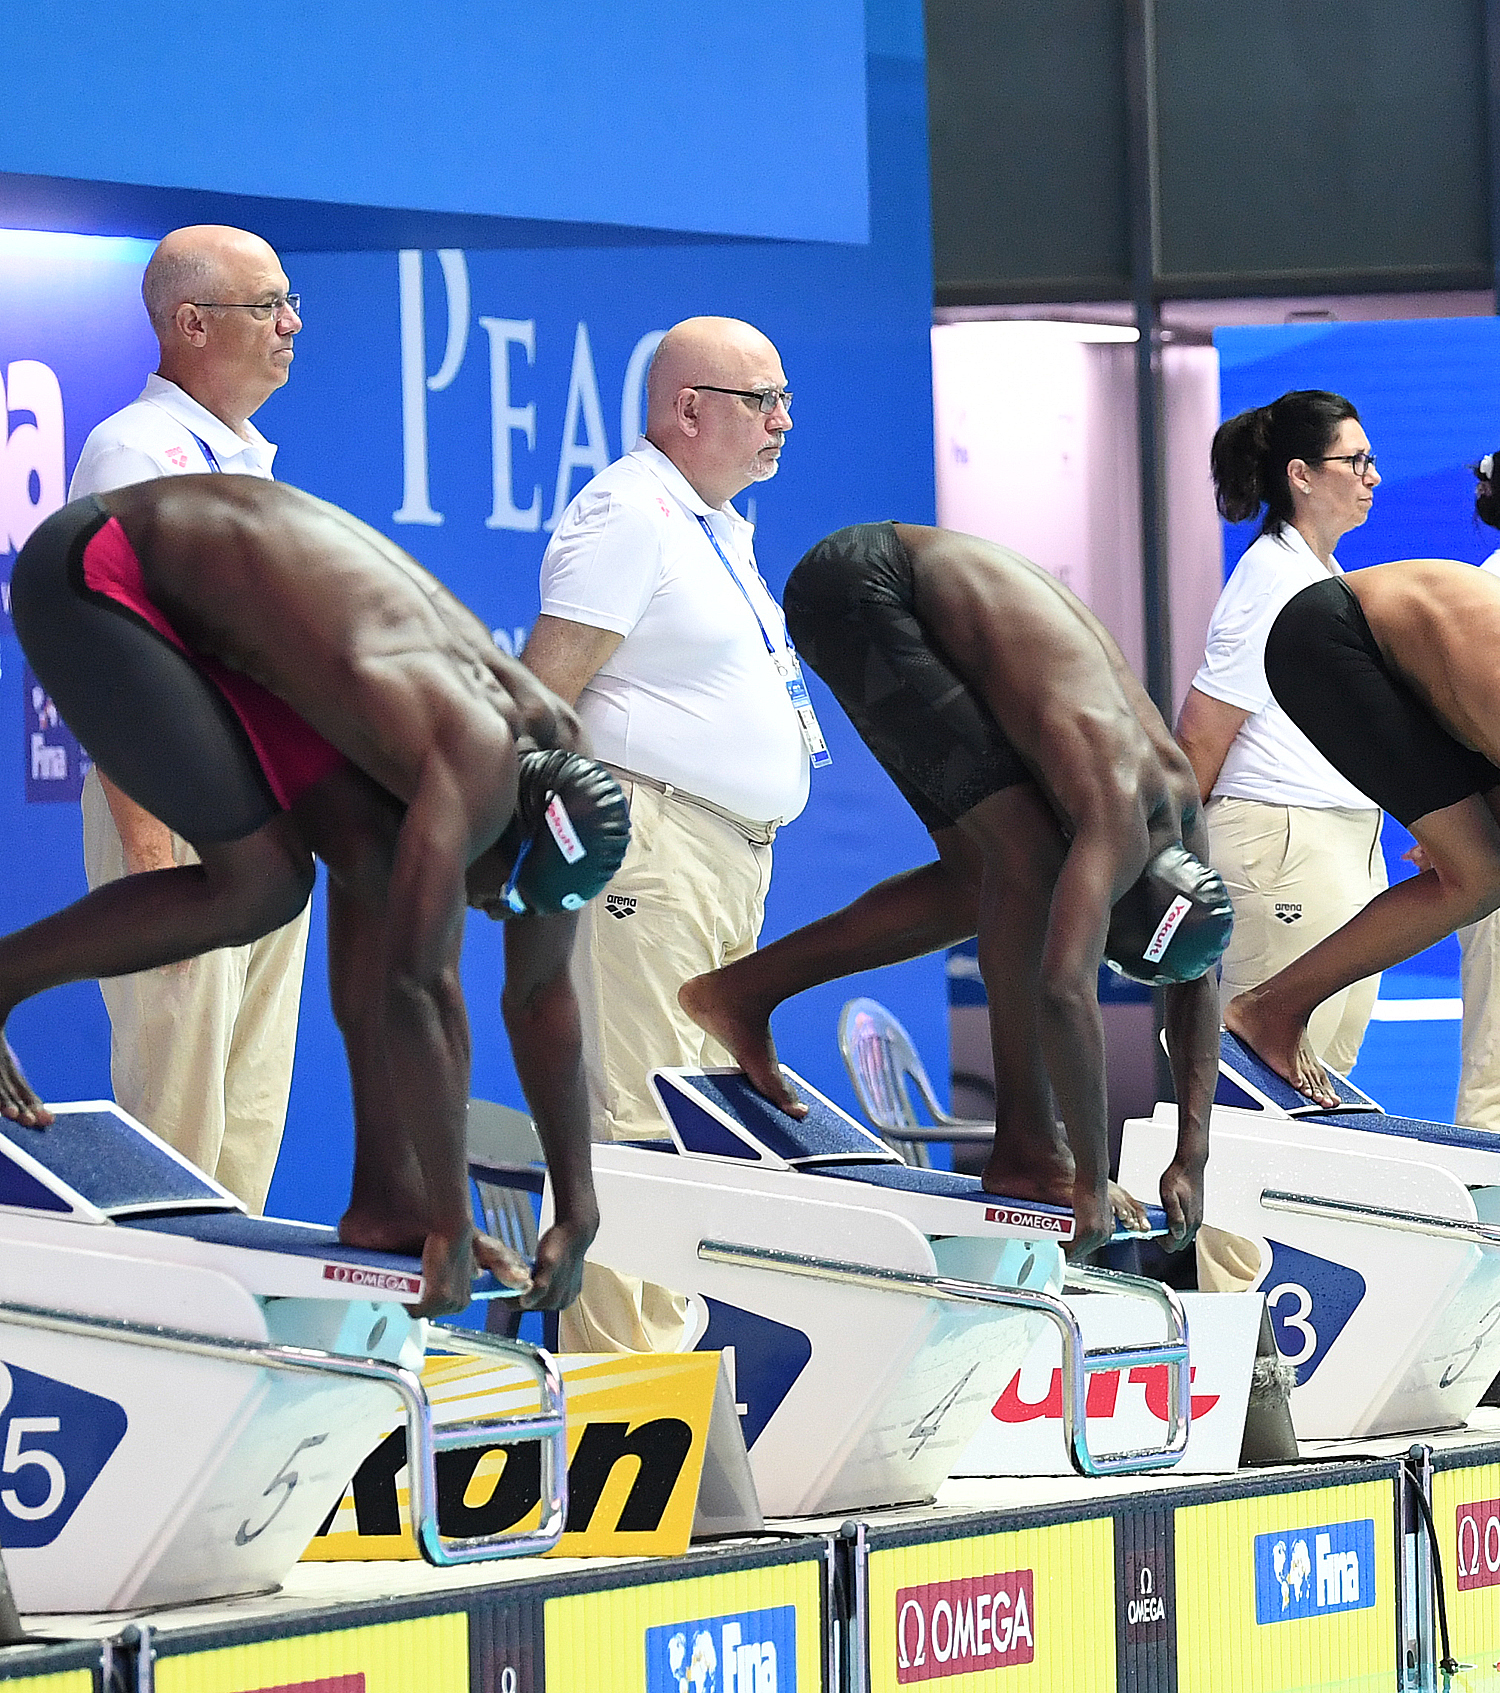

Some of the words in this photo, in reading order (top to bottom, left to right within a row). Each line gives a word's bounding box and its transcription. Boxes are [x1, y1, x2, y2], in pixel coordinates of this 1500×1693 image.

[607, 894, 637, 907] arena
[1275, 903, 1302, 912] arena
[1149, 903, 1185, 956] Yakult
[1010, 1212, 1062, 1232] OMEGA
[351, 1270, 409, 1292] OMEGA
[1267, 1282, 1317, 1366] 3
[0, 1416, 66, 1521] 5
[234, 1431, 330, 1547] 5
[931, 1586, 1034, 1663] OMEGA
[1127, 1597, 1166, 1625] OMEGA
